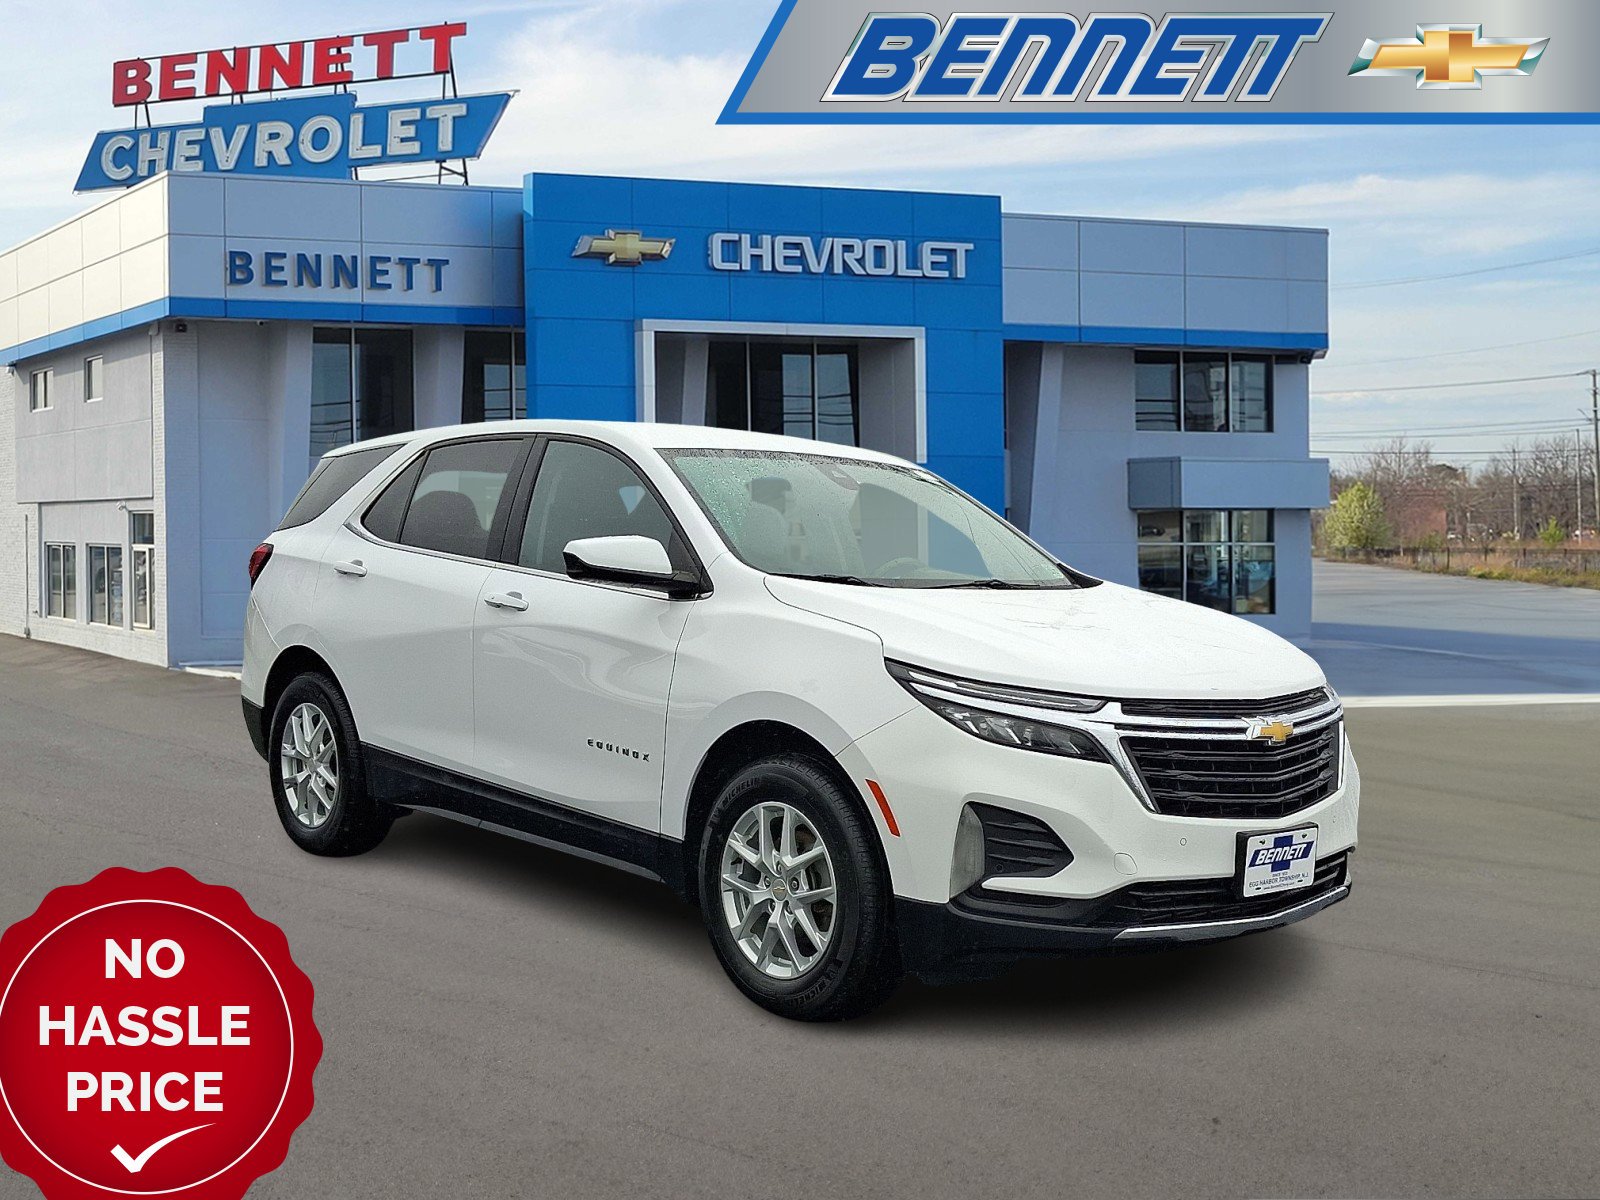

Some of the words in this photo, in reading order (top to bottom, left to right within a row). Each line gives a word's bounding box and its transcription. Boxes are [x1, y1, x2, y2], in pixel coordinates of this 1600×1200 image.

[112, 22, 467, 107] BENNETT
[100, 102, 468, 181] CHEVROLET
[227, 250, 450, 292] BENNETT
[708, 232, 975, 279] CHEVROLET
[587, 738, 650, 763] EQUINOX
[1255, 843, 1308, 865] BENNETT
